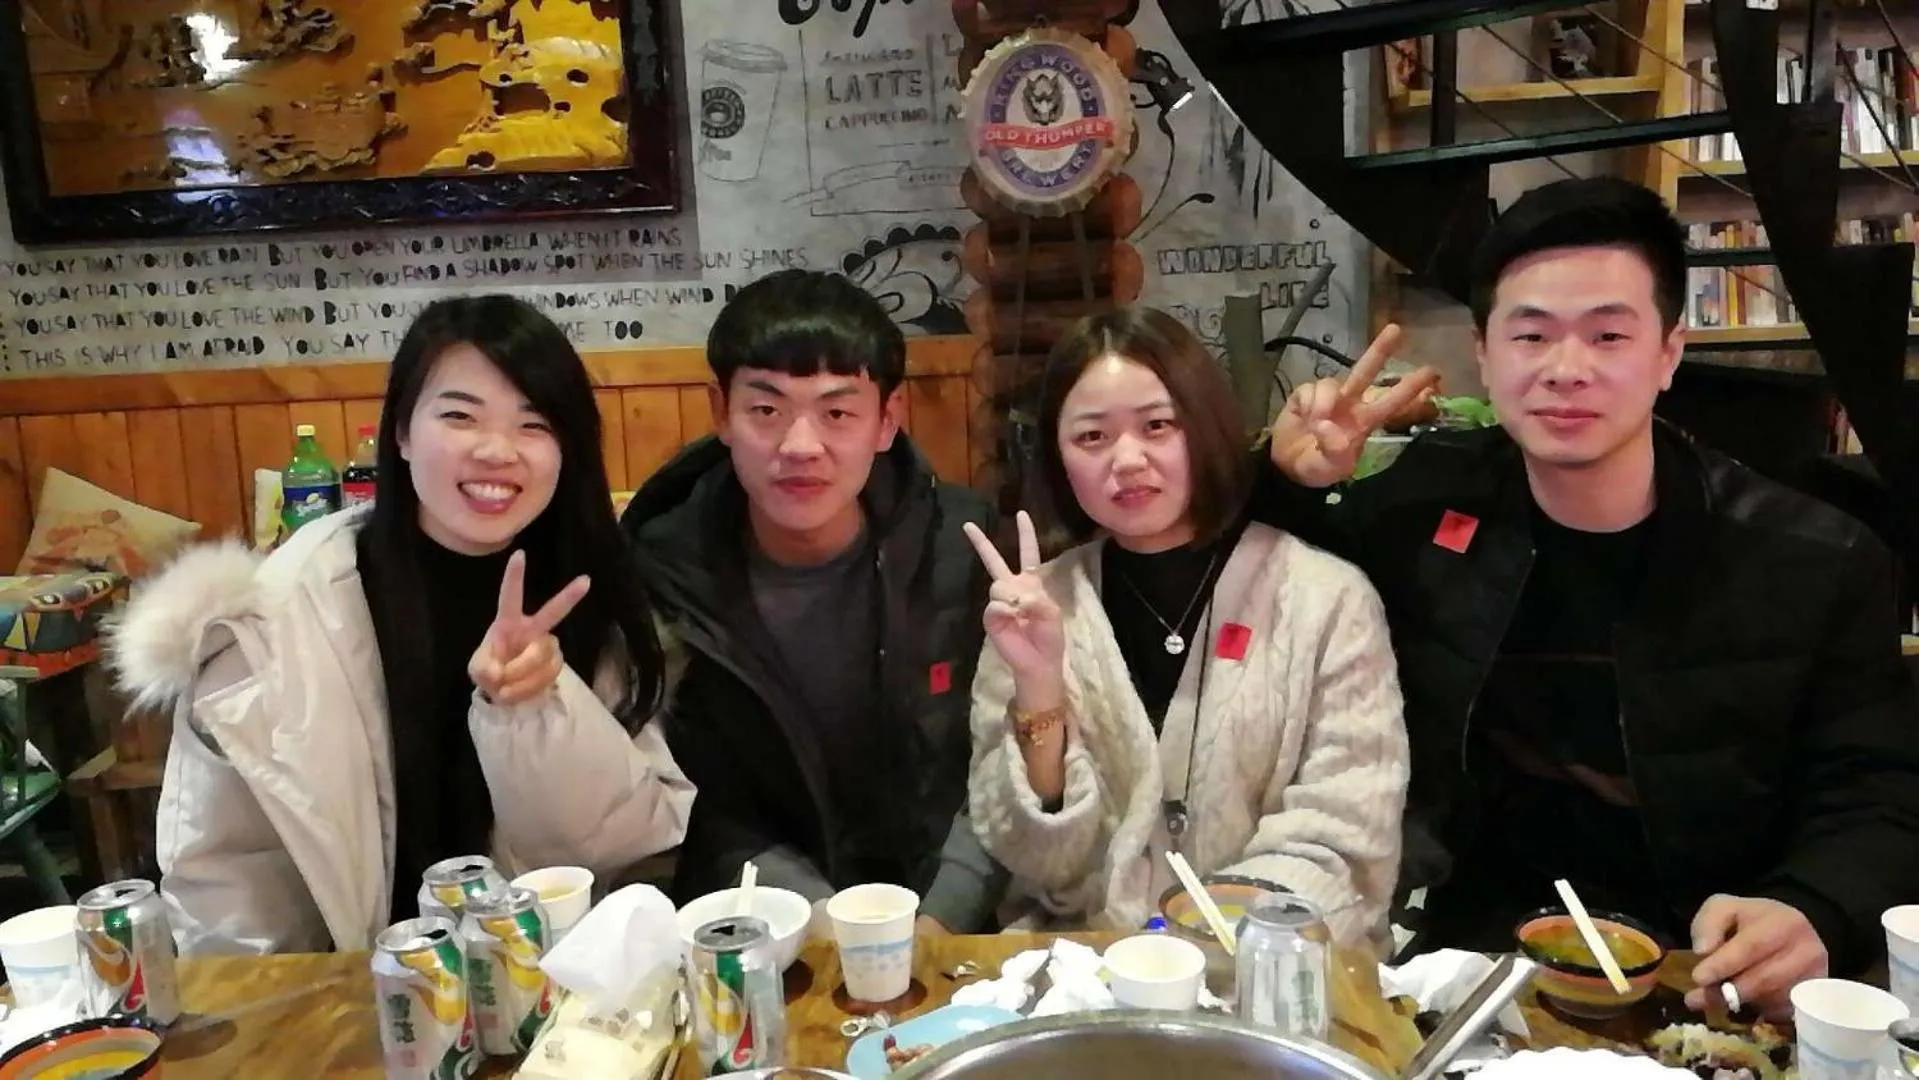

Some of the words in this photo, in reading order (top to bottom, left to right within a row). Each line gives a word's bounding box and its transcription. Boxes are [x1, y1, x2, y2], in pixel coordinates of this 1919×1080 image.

[825, 69, 923, 104] LATTE
[985, 128, 1019, 142] OLD
[1023, 121, 1108, 145] THUMPER
[6, 262, 41, 277] YOU
[47, 258, 76, 275] SAY
[83, 254, 125, 273] THAT
[132, 252, 169, 269] YOU
[174, 250, 213, 268] LOVE
[312, 243, 349, 261] YOU
[452, 231, 539, 255] UMBRELLA
[547, 230, 601, 251] WHEN
[603, 229, 620, 248] IT
[628, 227, 683, 249] RAINS
[1158, 241, 1332, 275] WONDERFUL
[8, 287, 47, 307] YOU
[48, 284, 81, 304] SAY
[85, 282, 129, 300] THAT
[134, 281, 171, 298] YOU
[175, 277, 215, 298] LOVE
[220, 274, 256, 292] THE
[263, 271, 301, 292] SUN
[357, 266, 400, 288] YOU
[402, 263, 441, 285] FIND
[446, 261, 458, 279] A
[462, 255, 539, 280] SHADOW
[591, 250, 645, 273] WHEN
[648, 251, 686, 273] THE
[694, 250, 733, 271] SUN
[740, 246, 810, 271] SHINES
[603, 287, 660, 309] WHEN
[664, 286, 714, 306] WIND
[14, 317, 52, 337] YOU
[54, 314, 88, 333] SAY
[91, 310, 134, 331] THAT
[140, 309, 178, 329] YOU
[181, 307, 225, 331] LOVE
[228, 304, 268, 328] THE
[268, 303, 316, 327] WIND
[367, 301, 406, 321] YOU
[604, 320, 644, 341] TOO
[18, 347, 67, 370] THIS
[98, 344, 142, 367] WHY
[165, 340, 195, 360] AM
[202, 335, 266, 359] AFRAID
[278, 334, 324, 357] YOU
[331, 332, 371, 354] SAY
